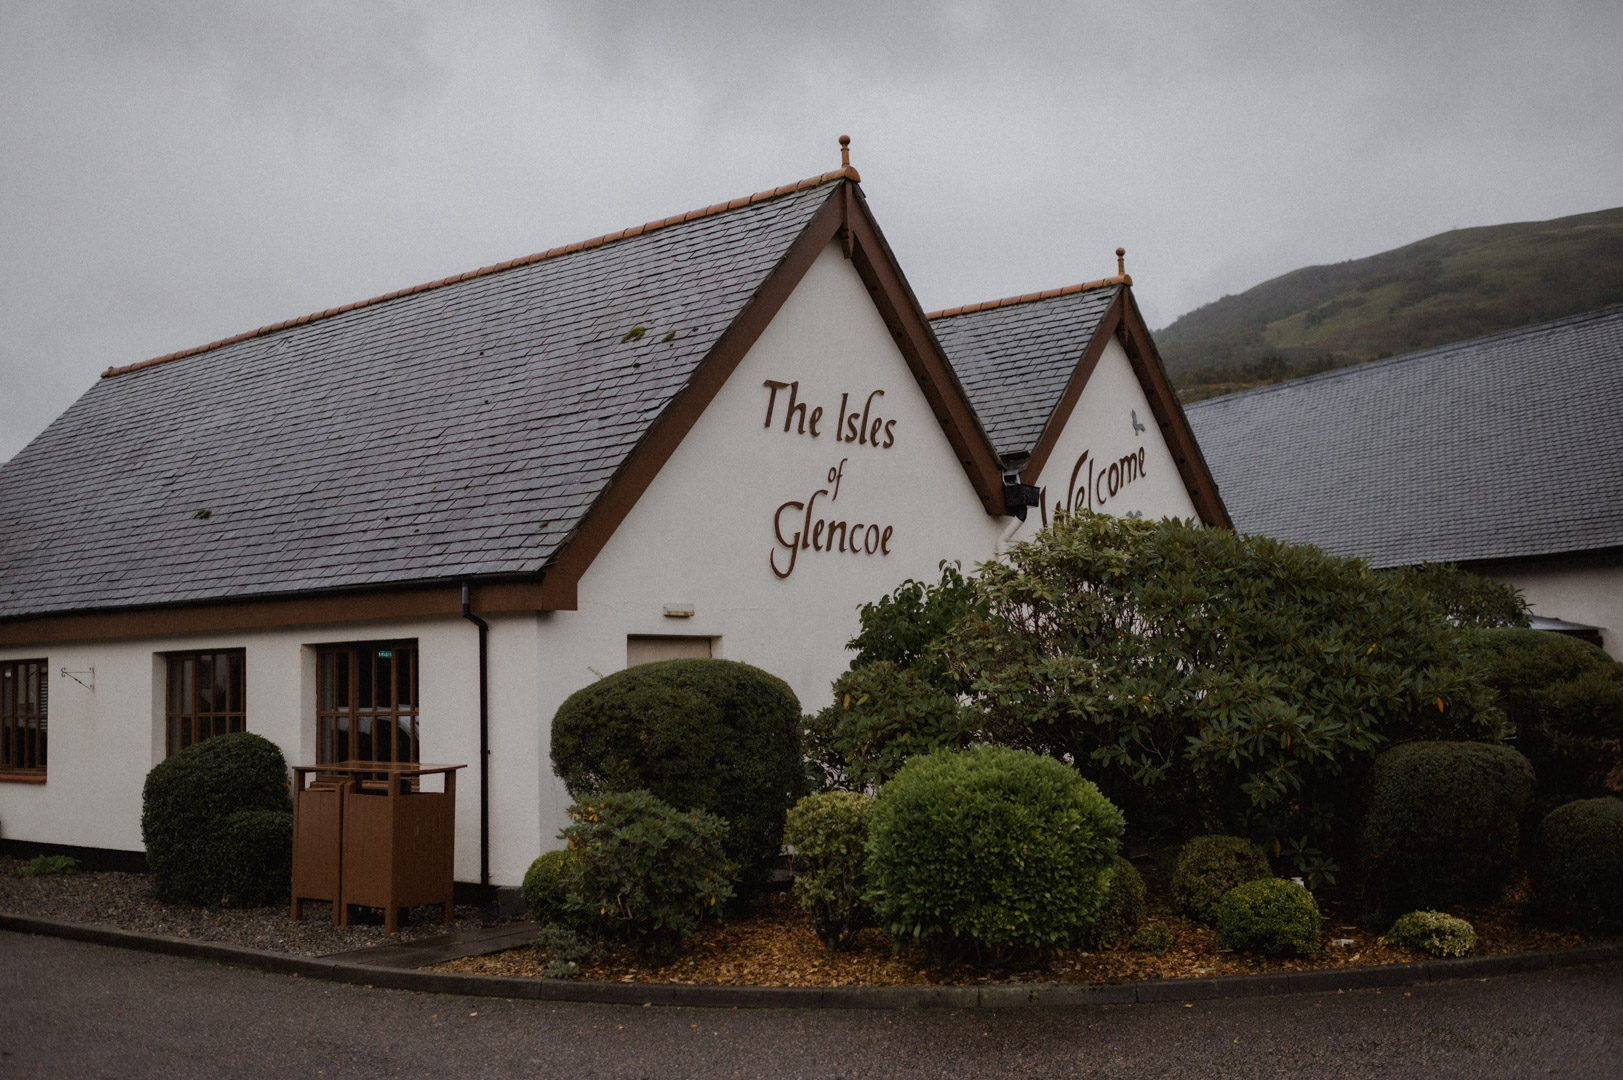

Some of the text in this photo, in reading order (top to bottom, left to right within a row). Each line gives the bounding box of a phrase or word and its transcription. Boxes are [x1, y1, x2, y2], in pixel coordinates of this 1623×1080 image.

[763, 379, 896, 448] The Isles
[828, 458, 848, 501] of
[770, 489, 893, 579] Glencoe
